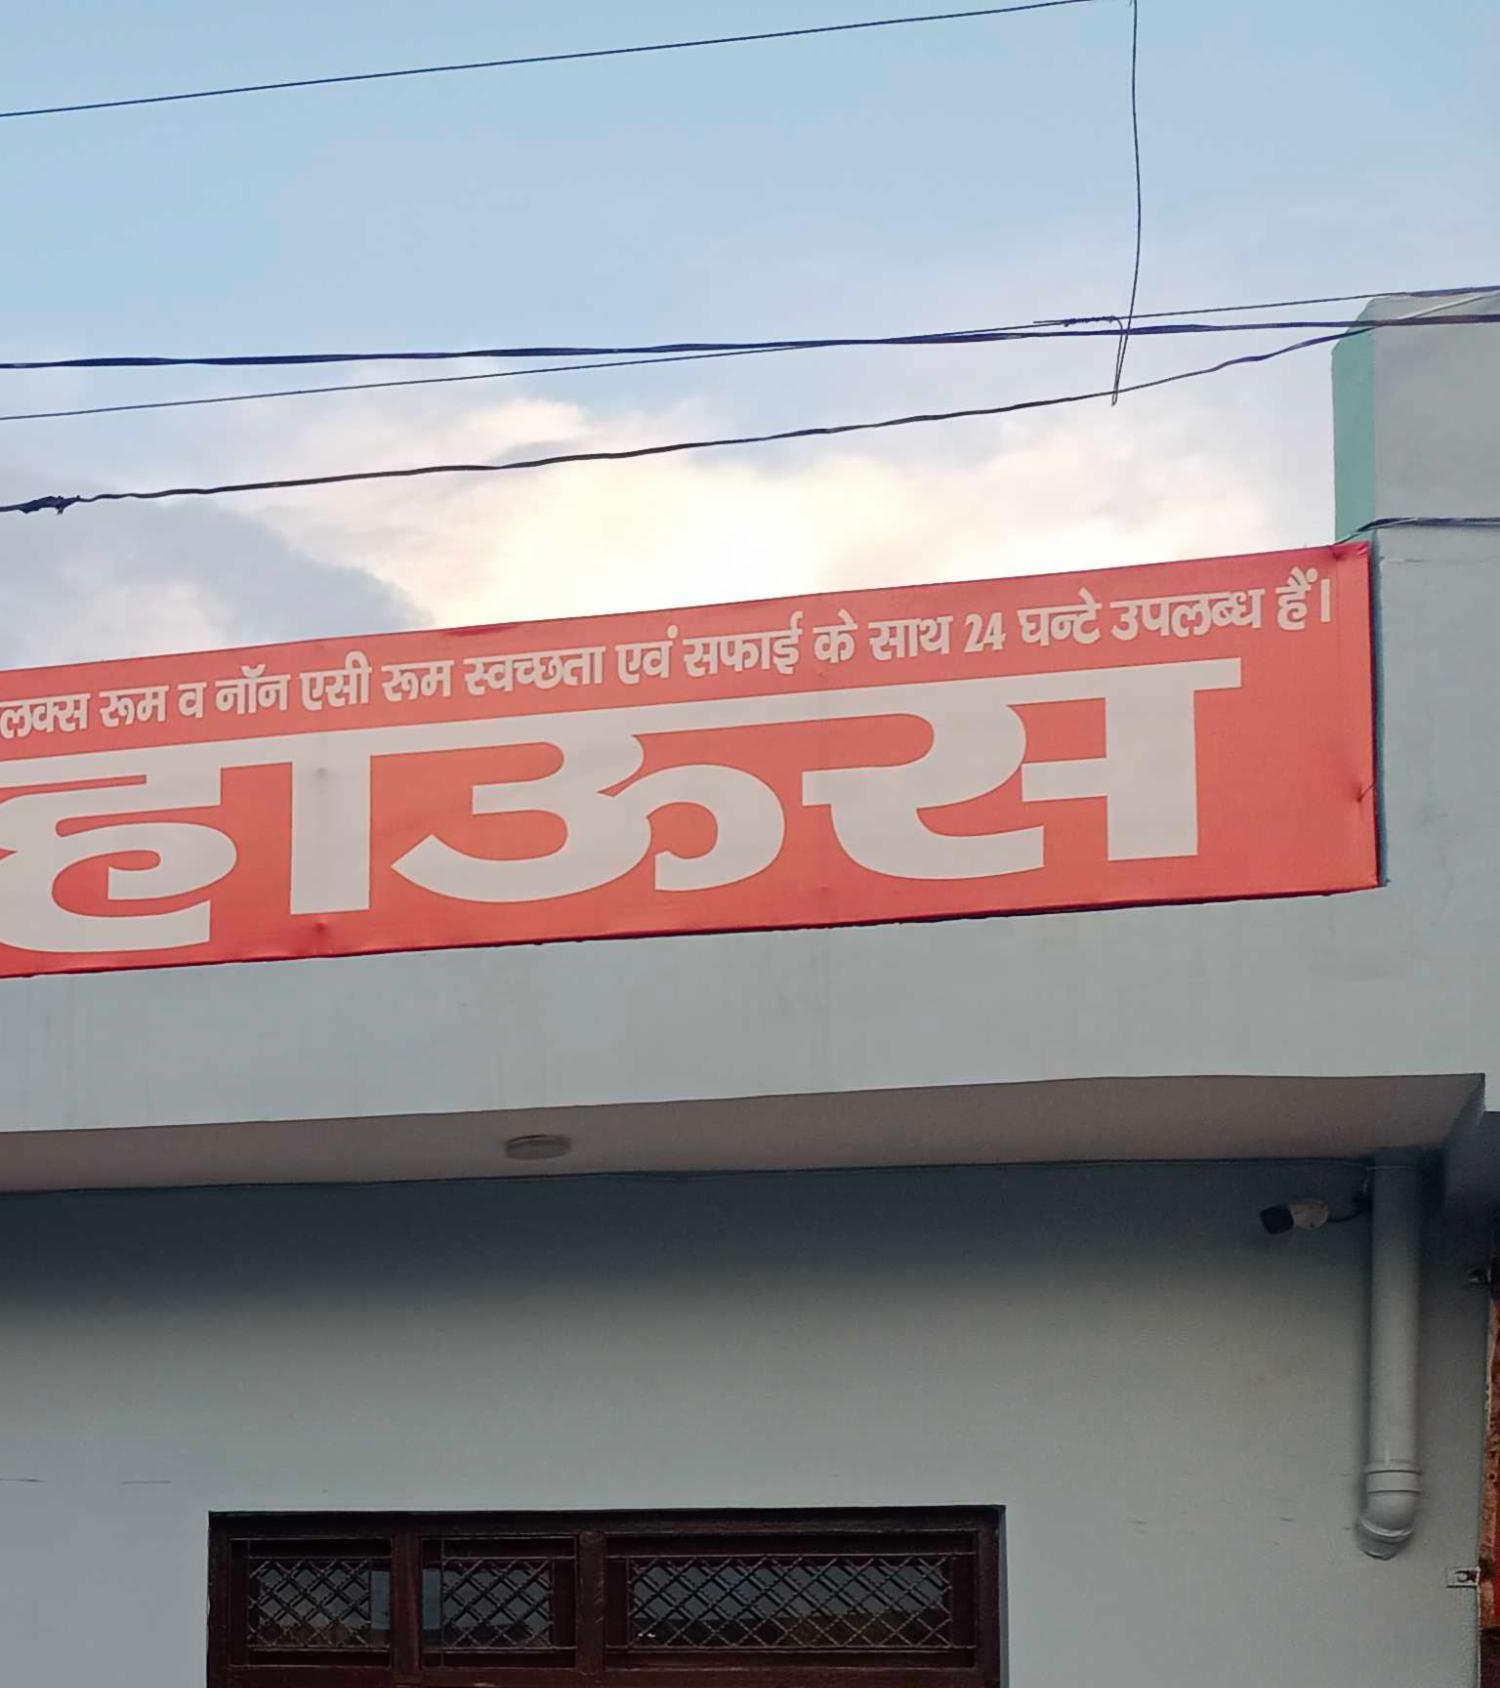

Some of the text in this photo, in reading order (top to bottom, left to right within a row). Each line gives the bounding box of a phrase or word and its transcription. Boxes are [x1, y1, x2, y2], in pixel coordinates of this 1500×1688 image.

[99, 685, 169, 727] रूम
[178, 682, 207, 719] व
[216, 664, 291, 715] नॉन
[299, 651, 372, 711] एसी
[381, 659, 454, 702] रूम
[464, 646, 605, 693] स्वच्छता
[615, 625, 678, 685] एवं
[683, 610, 803, 677] सफाई
[813, 608, 858, 663] के
[868, 615, 953, 661] साथ
[965, 612, 1006, 653] 24
[1018, 587, 1102, 647] घन्टे
[1110, 588, 1264, 641] उपलब्ध
